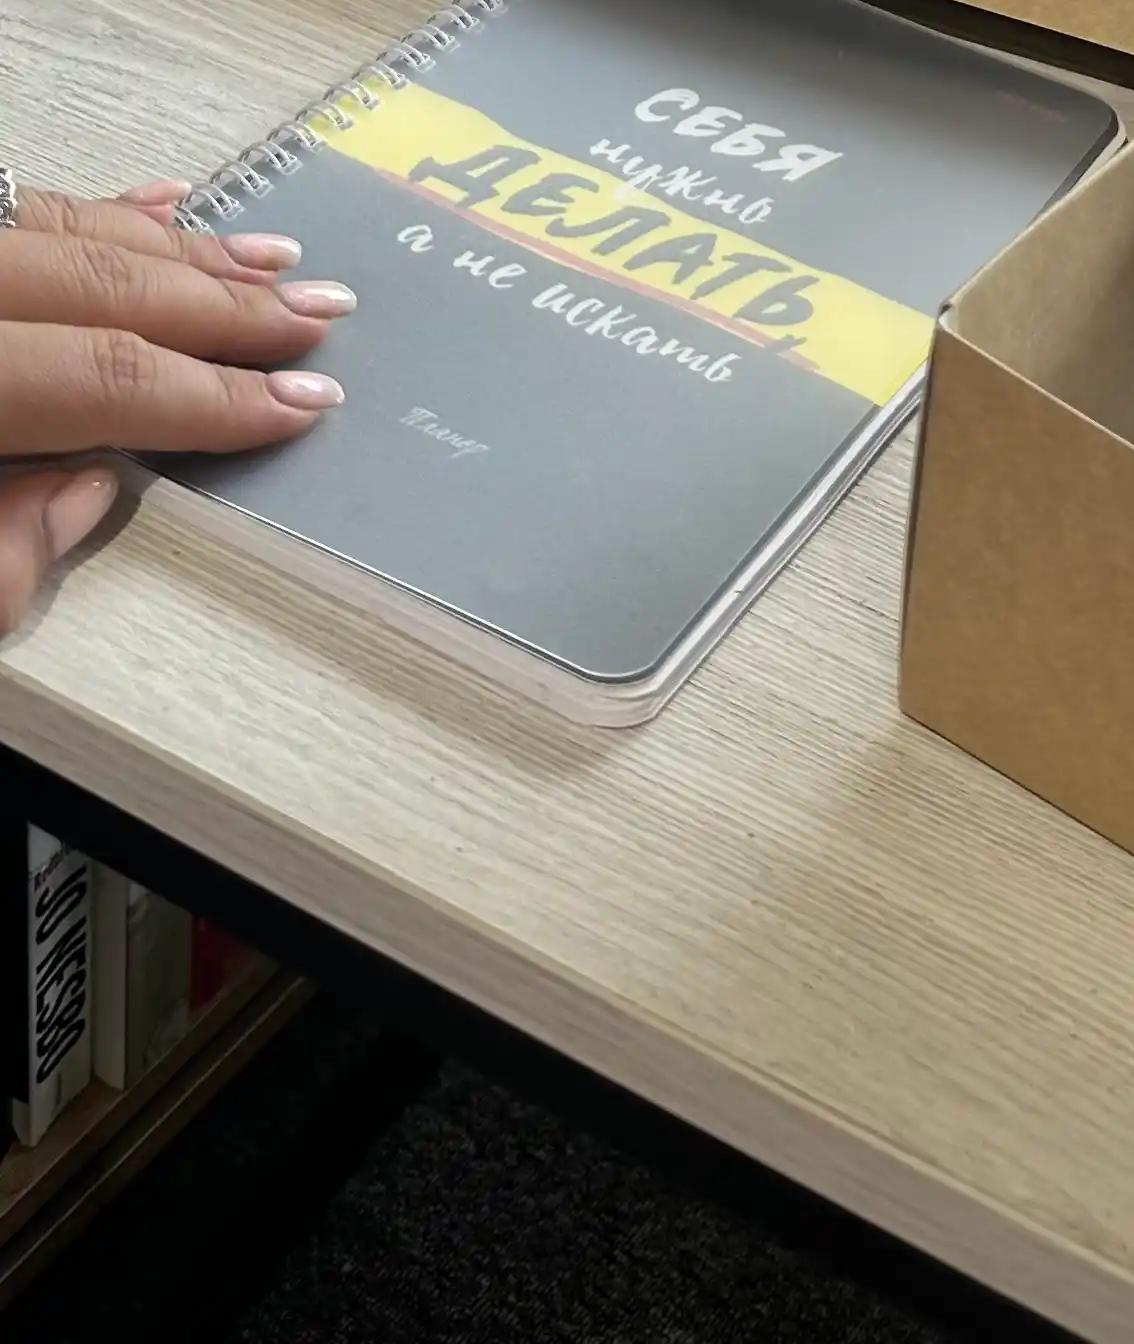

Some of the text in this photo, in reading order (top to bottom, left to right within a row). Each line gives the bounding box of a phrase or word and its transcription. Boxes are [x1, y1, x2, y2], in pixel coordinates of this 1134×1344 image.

[588, 137, 777, 225] нужно
[633, 87, 845, 183] СЕБЯ
[408, 143, 821, 329] ДЕЛАТЬ
[397, 223, 747, 384] а не искать
[35, 865, 87, 945] JO
